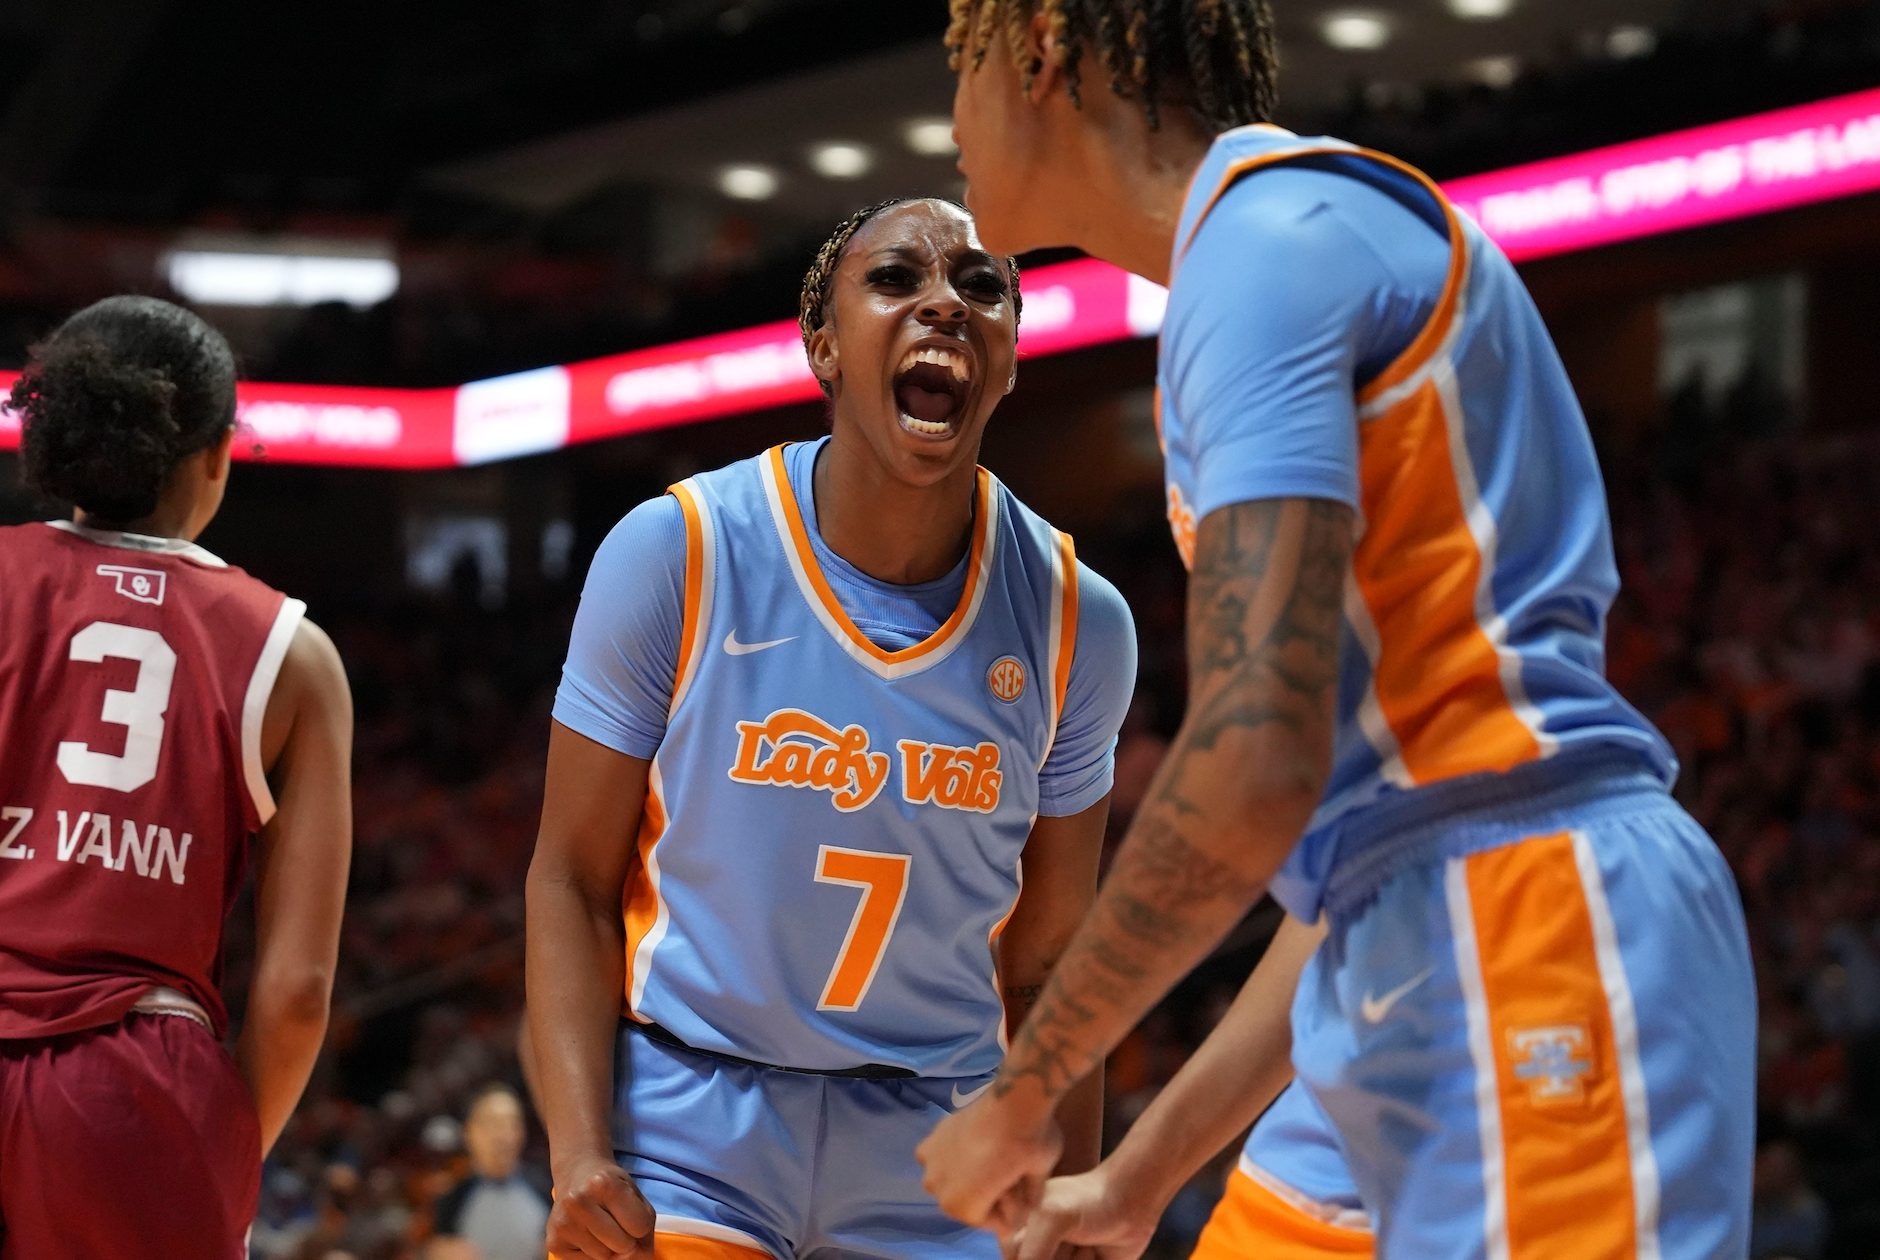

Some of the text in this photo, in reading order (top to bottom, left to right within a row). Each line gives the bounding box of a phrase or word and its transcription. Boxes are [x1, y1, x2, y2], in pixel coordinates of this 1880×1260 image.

[56, 621, 177, 793] 3
[992, 661, 1023, 698] SEC
[728, 708, 1002, 814] Lady Vols
[0, 806, 193, 885] Z. VANN
[813, 844, 912, 1013] 7
